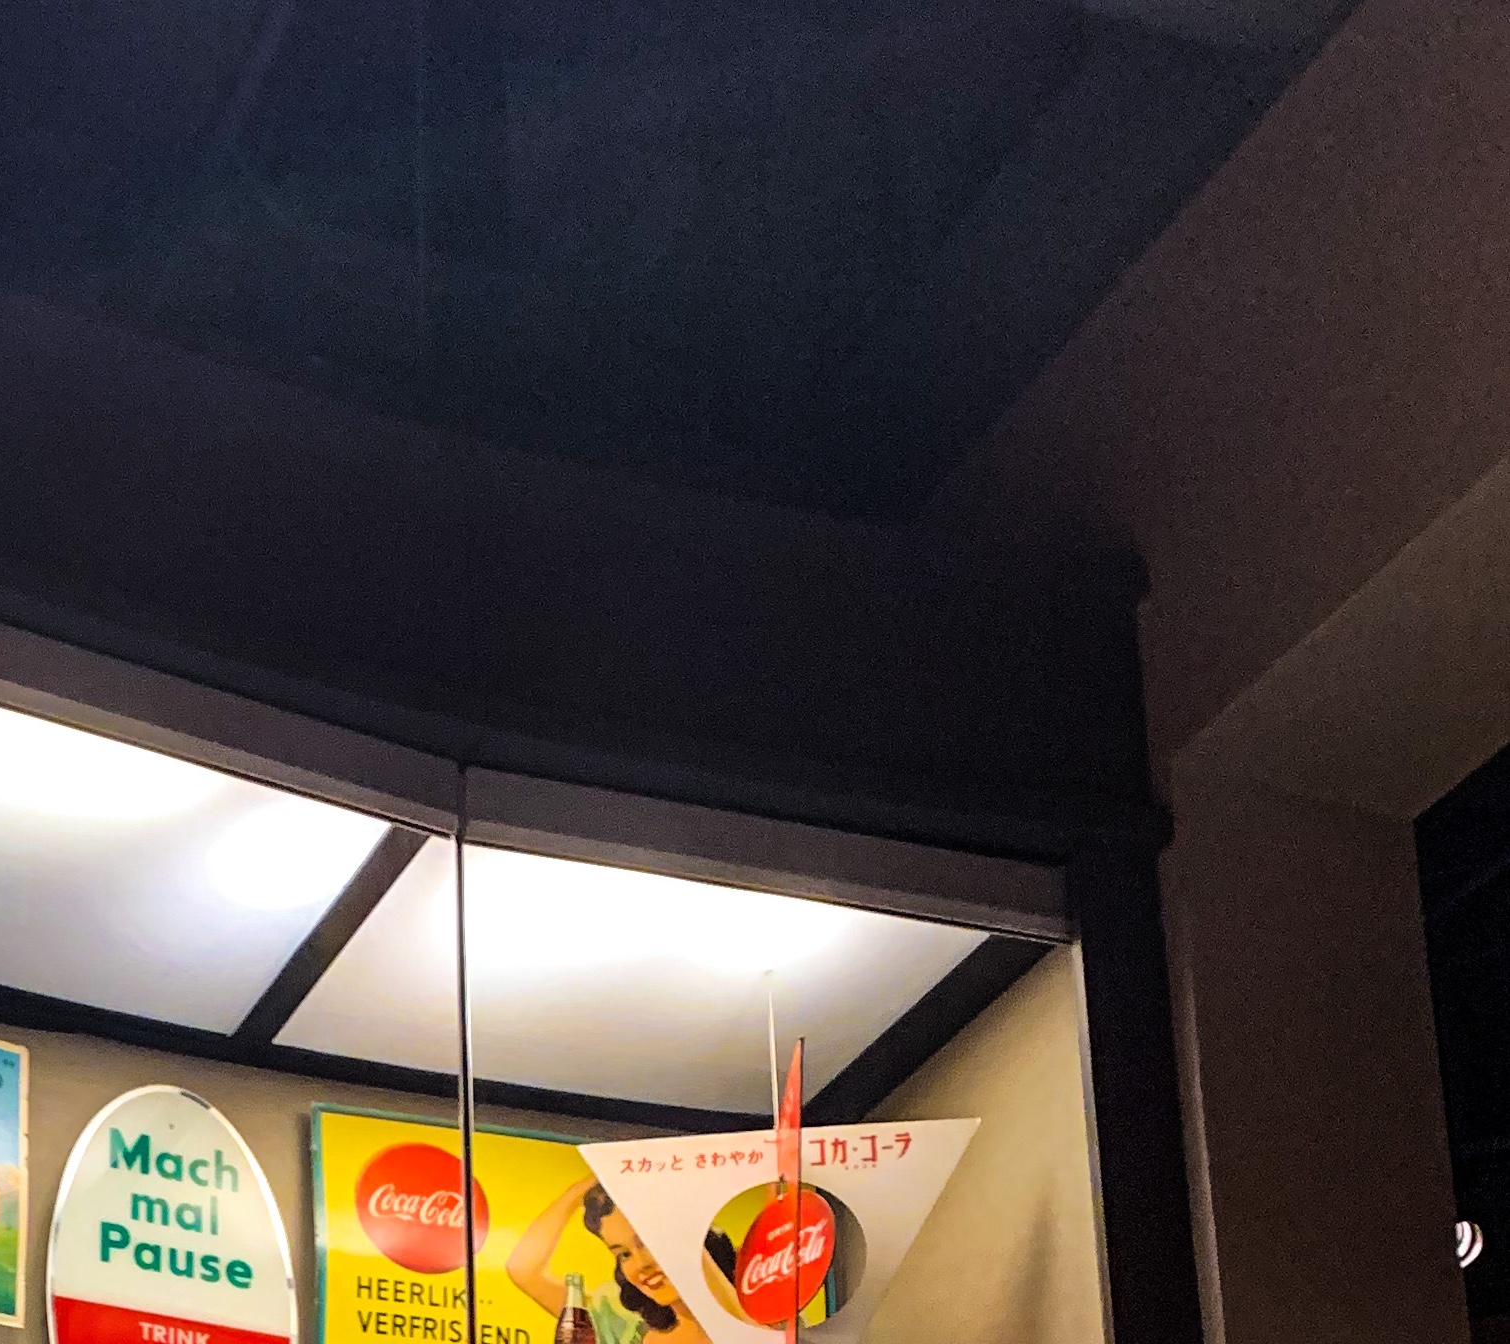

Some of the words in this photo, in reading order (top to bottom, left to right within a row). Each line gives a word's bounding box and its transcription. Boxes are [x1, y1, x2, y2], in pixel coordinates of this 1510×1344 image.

[109, 1127, 240, 1193] Mach
[130, 1191, 220, 1236] mal
[99, 1220, 255, 1290] Pause
